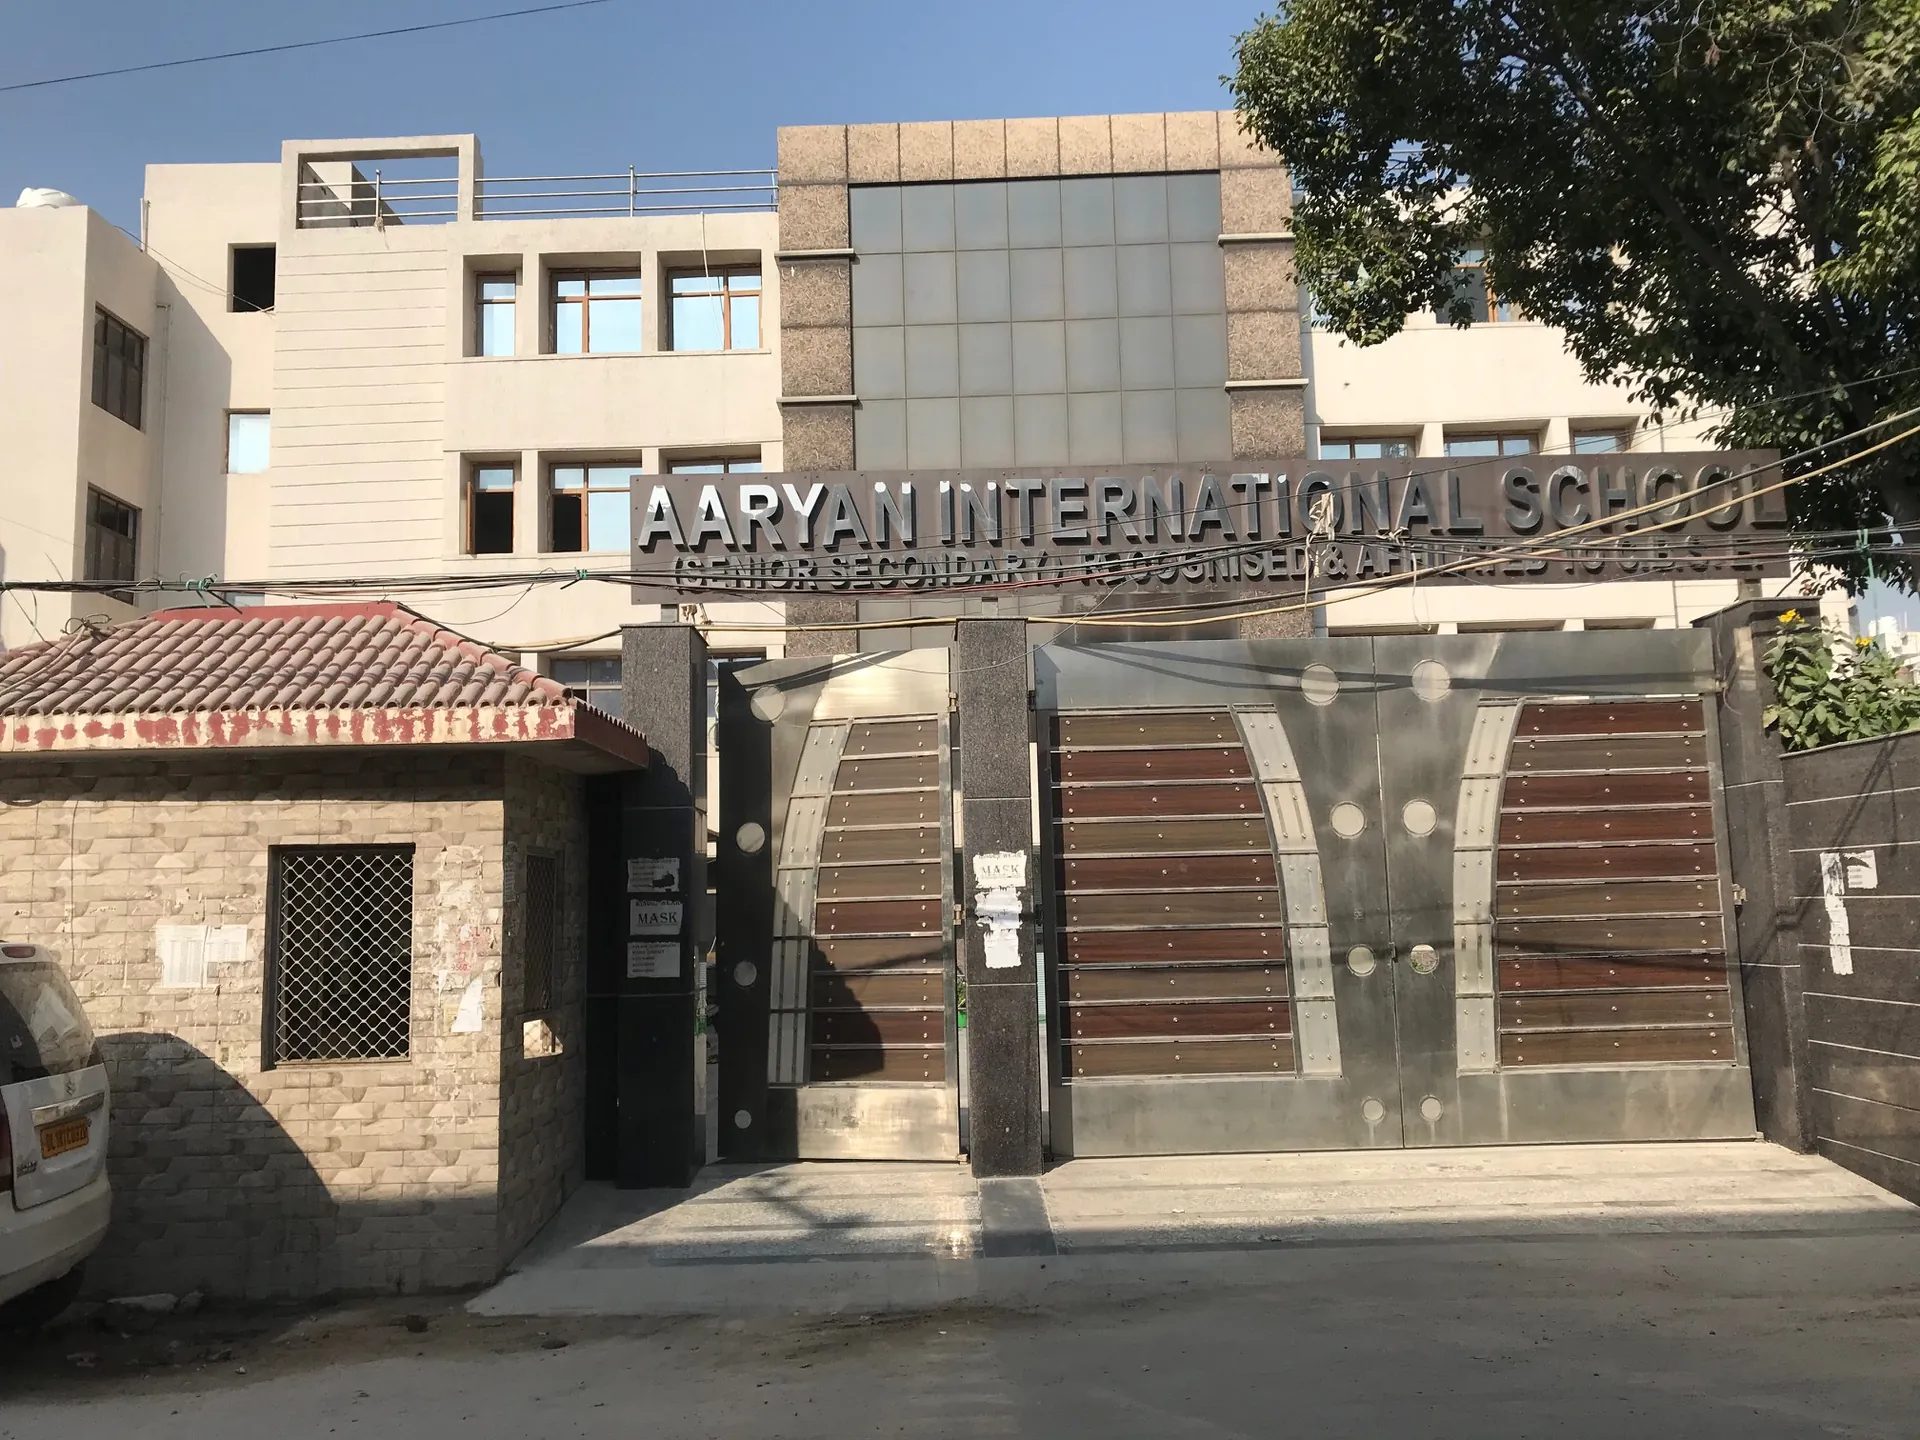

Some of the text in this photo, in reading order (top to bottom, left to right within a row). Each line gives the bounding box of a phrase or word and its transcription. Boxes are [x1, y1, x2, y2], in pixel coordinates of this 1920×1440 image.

[638, 463, 1788, 549] AARYAN INTERNATIONAL SCHOOL
[1324, 542, 1348, 579] &
[980, 864, 1020, 876] MASK
[637, 912, 678, 924] MASK
